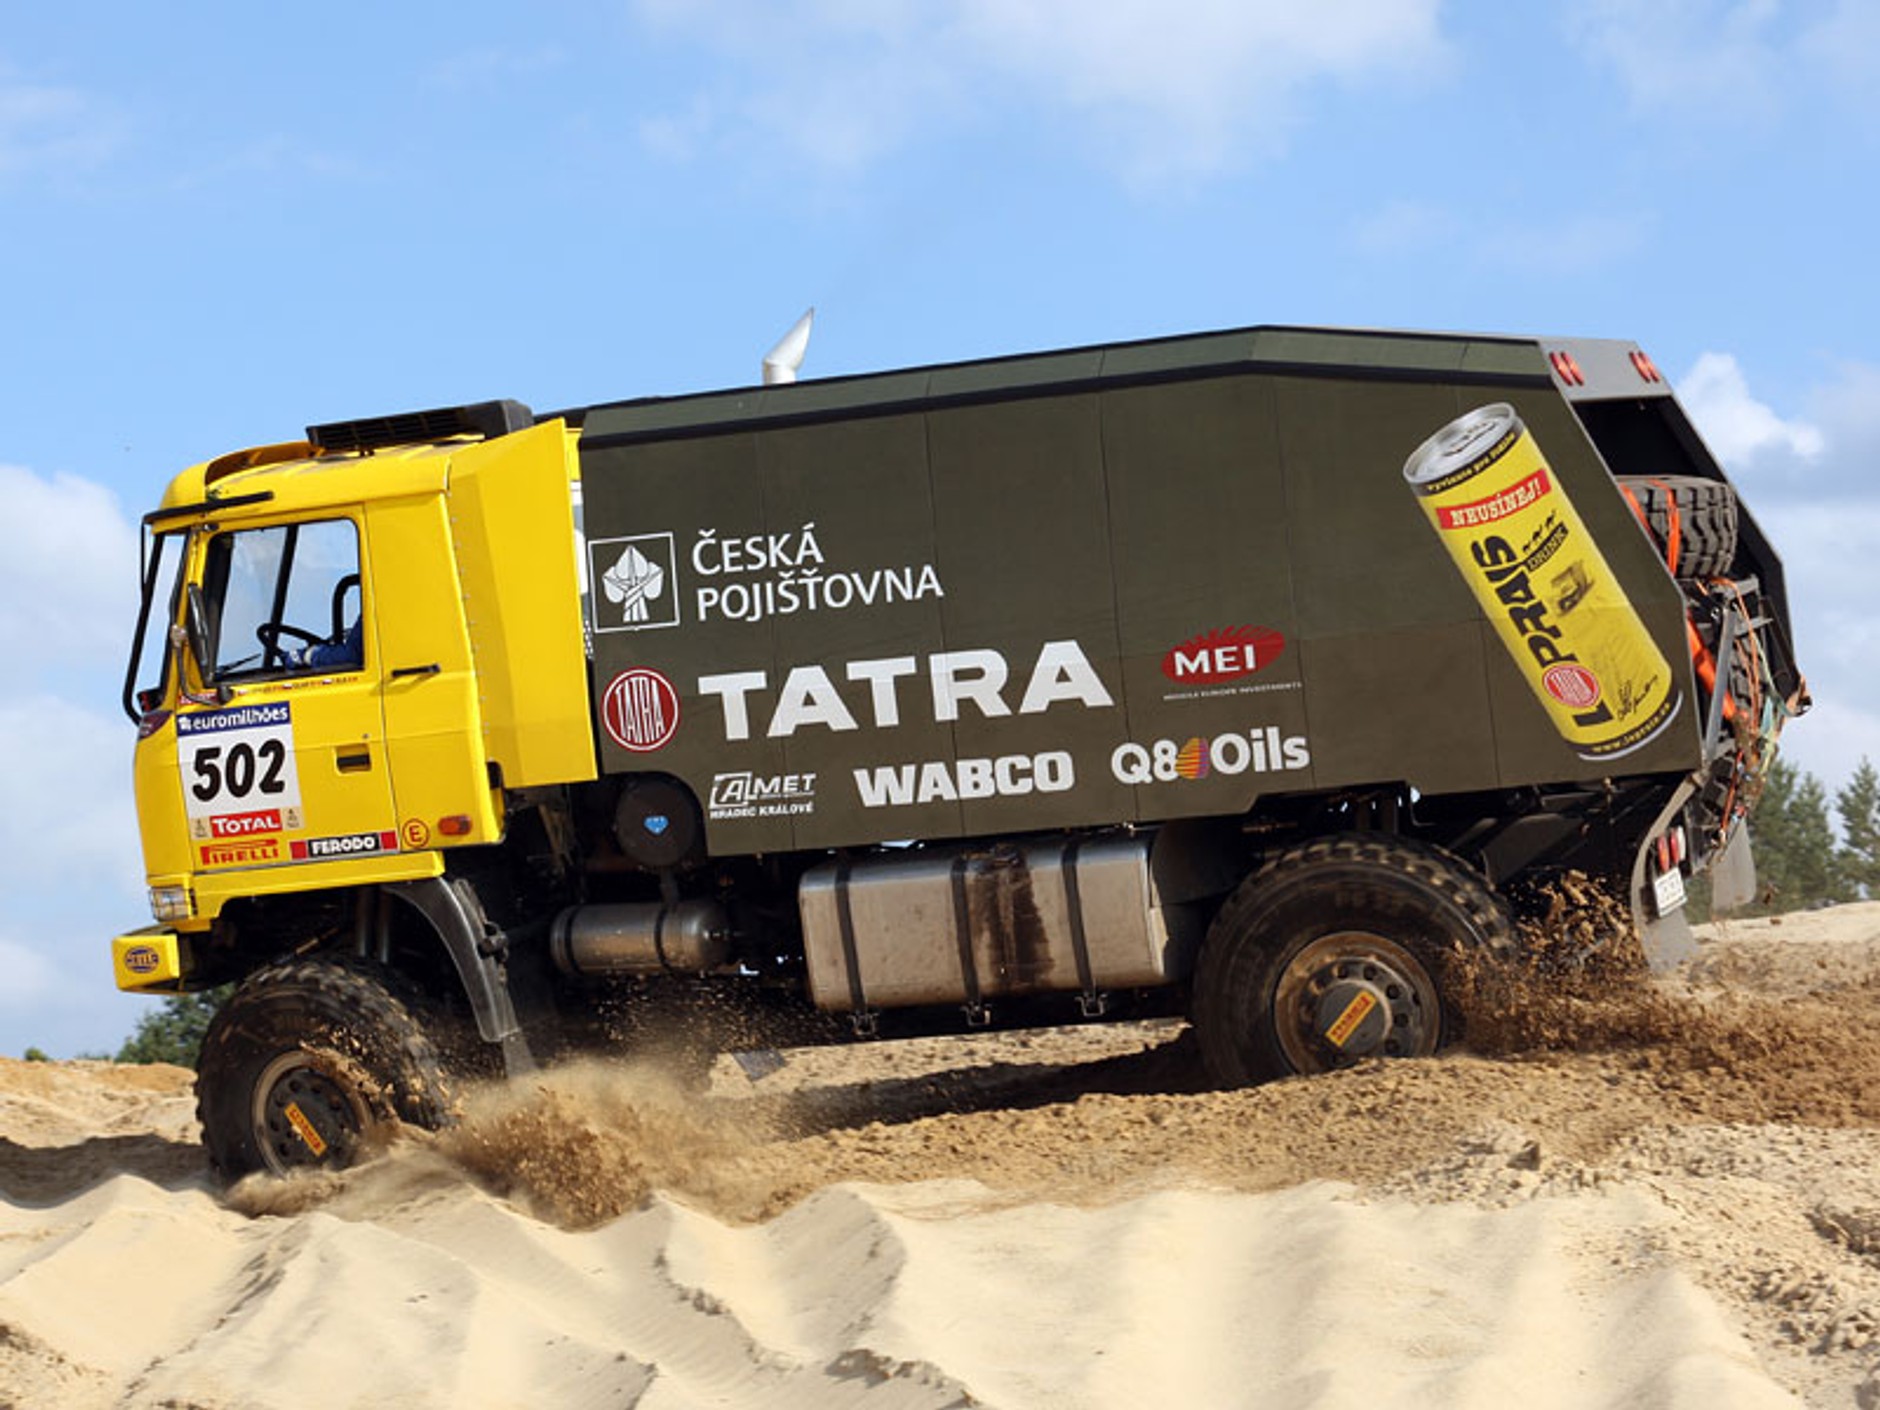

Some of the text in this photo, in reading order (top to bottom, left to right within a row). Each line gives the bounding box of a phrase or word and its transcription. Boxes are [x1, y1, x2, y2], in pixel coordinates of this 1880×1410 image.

[692, 522, 824, 575] ČESKÁ
[698, 565, 944, 622] POJIŠŤOVNA
[1174, 644, 1256, 676] MEI
[615, 676, 666, 744] TATRA
[698, 639, 1115, 741] TATRA
[193, 707, 288, 730] euromilhões
[192, 739, 286, 801] 502
[853, 751, 1075, 807] WABCO
[1111, 726, 1310, 784] Q8 Oils
[759, 801, 814, 816] KRÁLOVÉ
[200, 839, 279, 865] PIRELLI
[312, 834, 376, 854] FERODO
